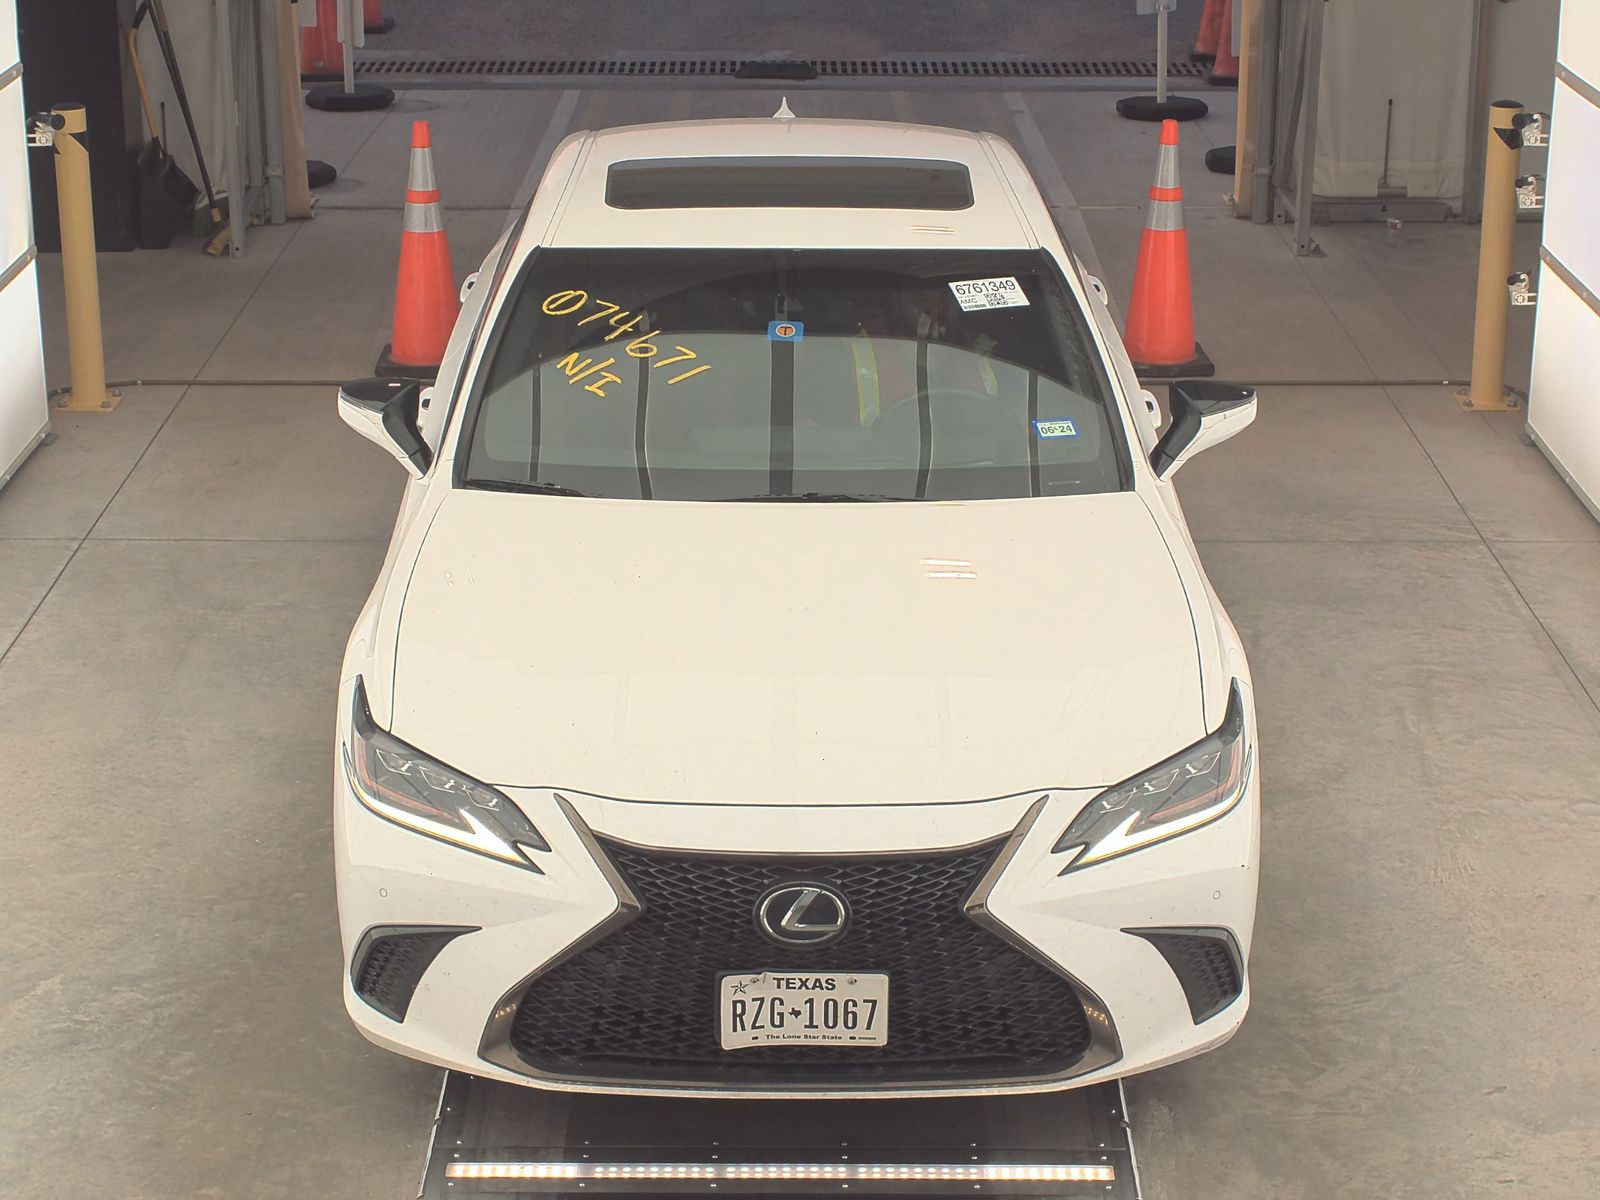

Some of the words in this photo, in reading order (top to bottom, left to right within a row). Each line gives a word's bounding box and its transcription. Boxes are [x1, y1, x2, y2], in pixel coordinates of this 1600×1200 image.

[955, 280, 1016, 295] 6761349
[542, 290, 712, 385] 074671
[1040, 426, 1055, 435] 06
[1058, 425, 1073, 433] 24
[772, 977, 837, 991] TEXAS
[731, 997, 785, 1033] RZG
[803, 997, 878, 1031] 1067
